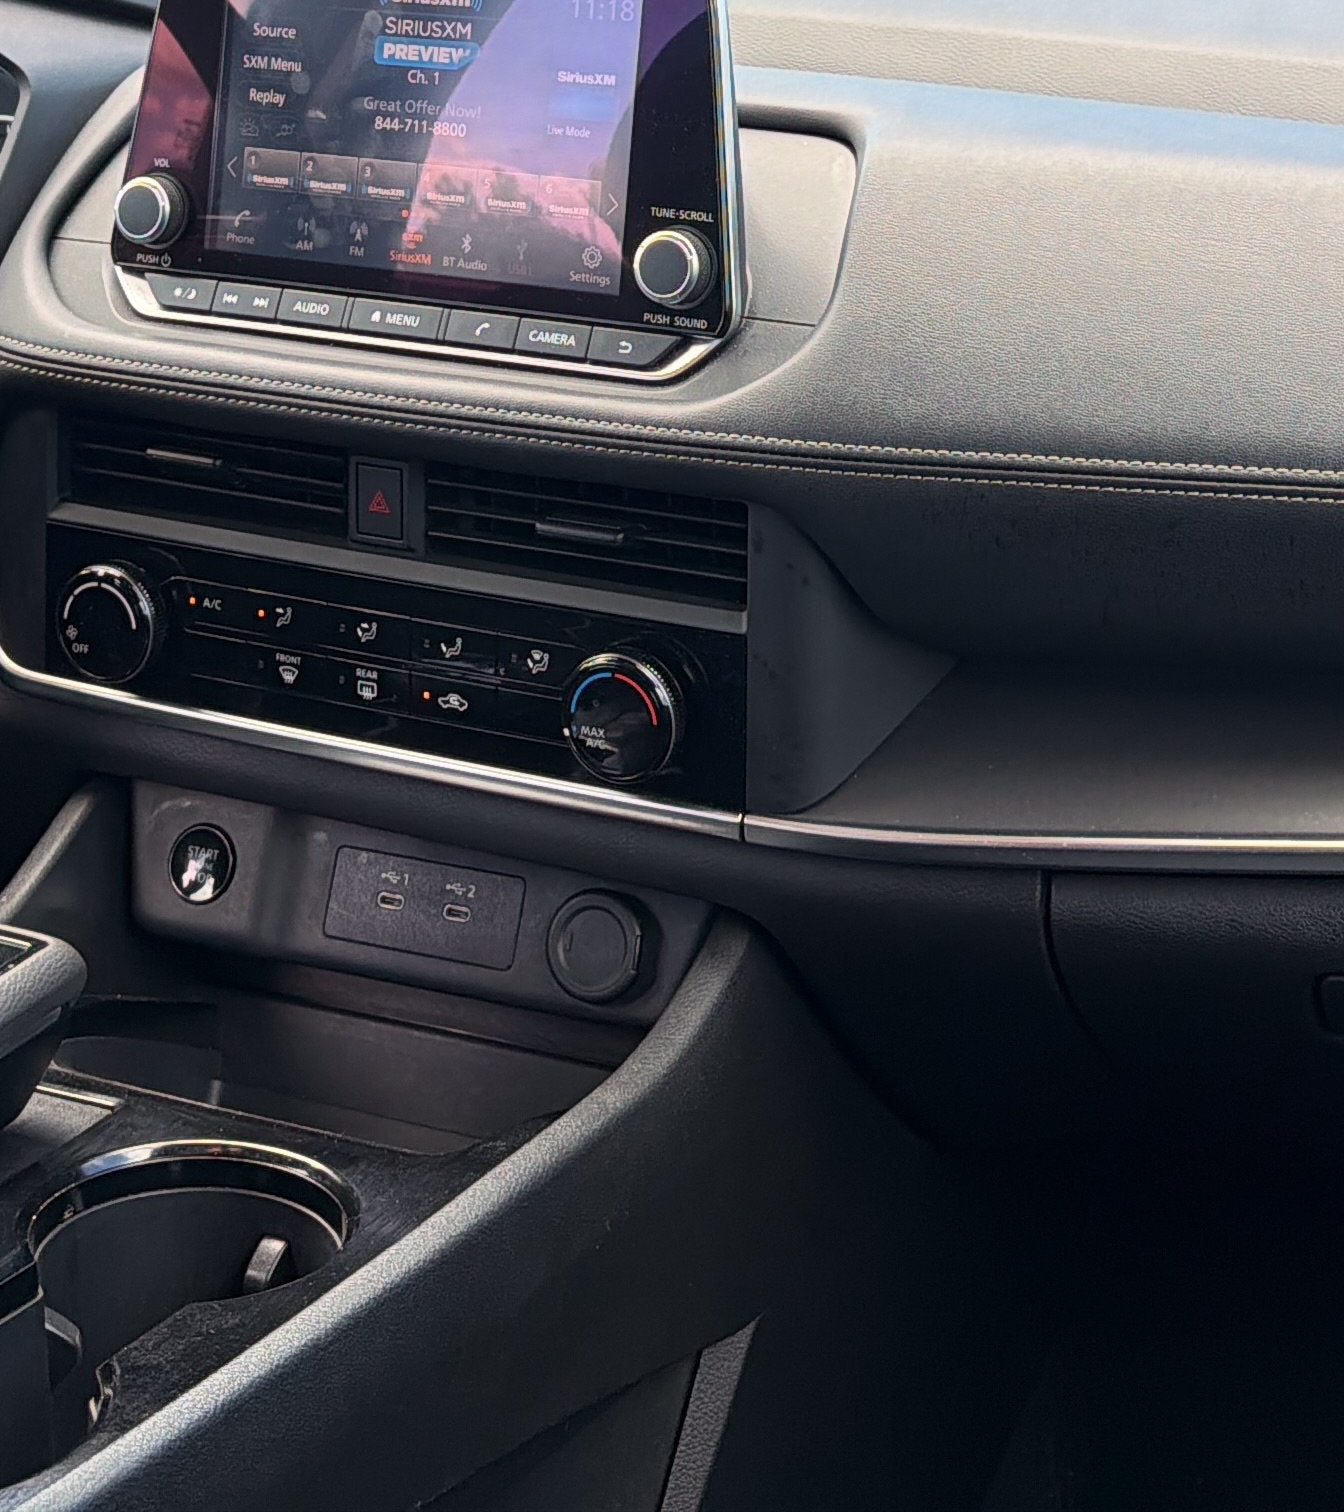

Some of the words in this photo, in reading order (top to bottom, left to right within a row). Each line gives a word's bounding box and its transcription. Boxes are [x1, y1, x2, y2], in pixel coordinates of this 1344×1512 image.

[253, 23, 297, 39] Source
[385, 17, 472, 40] SIRIUSXM
[383, 43, 470, 64] PREVIEW
[243, 55, 269, 70] SXM
[270, 57, 302, 72] Menu
[407, 70, 429, 85] Ch.
[433, 73, 440, 85] 1
[558, 72, 616, 86] SiriusXM
[249, 88, 286, 108] Replay
[364, 96, 401, 112] Great
[405, 100, 442, 117] Offer
[445, 102, 482, 119] Now!
[374, 115, 467, 137] 844-711-8800
[547, 124, 564, 135] Live
[565, 125, 591, 138] Mode
[154, 158, 170, 168] VOL
[226, 232, 255, 246] Phone
[296, 240, 313, 251] AM
[349, 246, 364, 257] FM
[389, 250, 432, 266] SiriusXM
[136, 254, 159, 265] PUSH
[442, 256, 455, 267] BT
[457, 258, 488, 272] Audio
[569, 270, 611, 288] Settings
[293, 300, 330, 316] AUDIO
[385, 312, 420, 328] MENU
[643, 313, 670, 325] PUSH
[674, 316, 708, 329] SOUND
[529, 329, 576, 347] CAMERA
[202, 597, 222, 611] A/C
[72, 642, 90, 655] OFF
[276, 652, 301, 666] FRONT
[356, 667, 378, 680] REAR
[580, 725, 605, 738] MAX
[188, 845, 220, 860] START
[467, 884, 476, 898] 2
